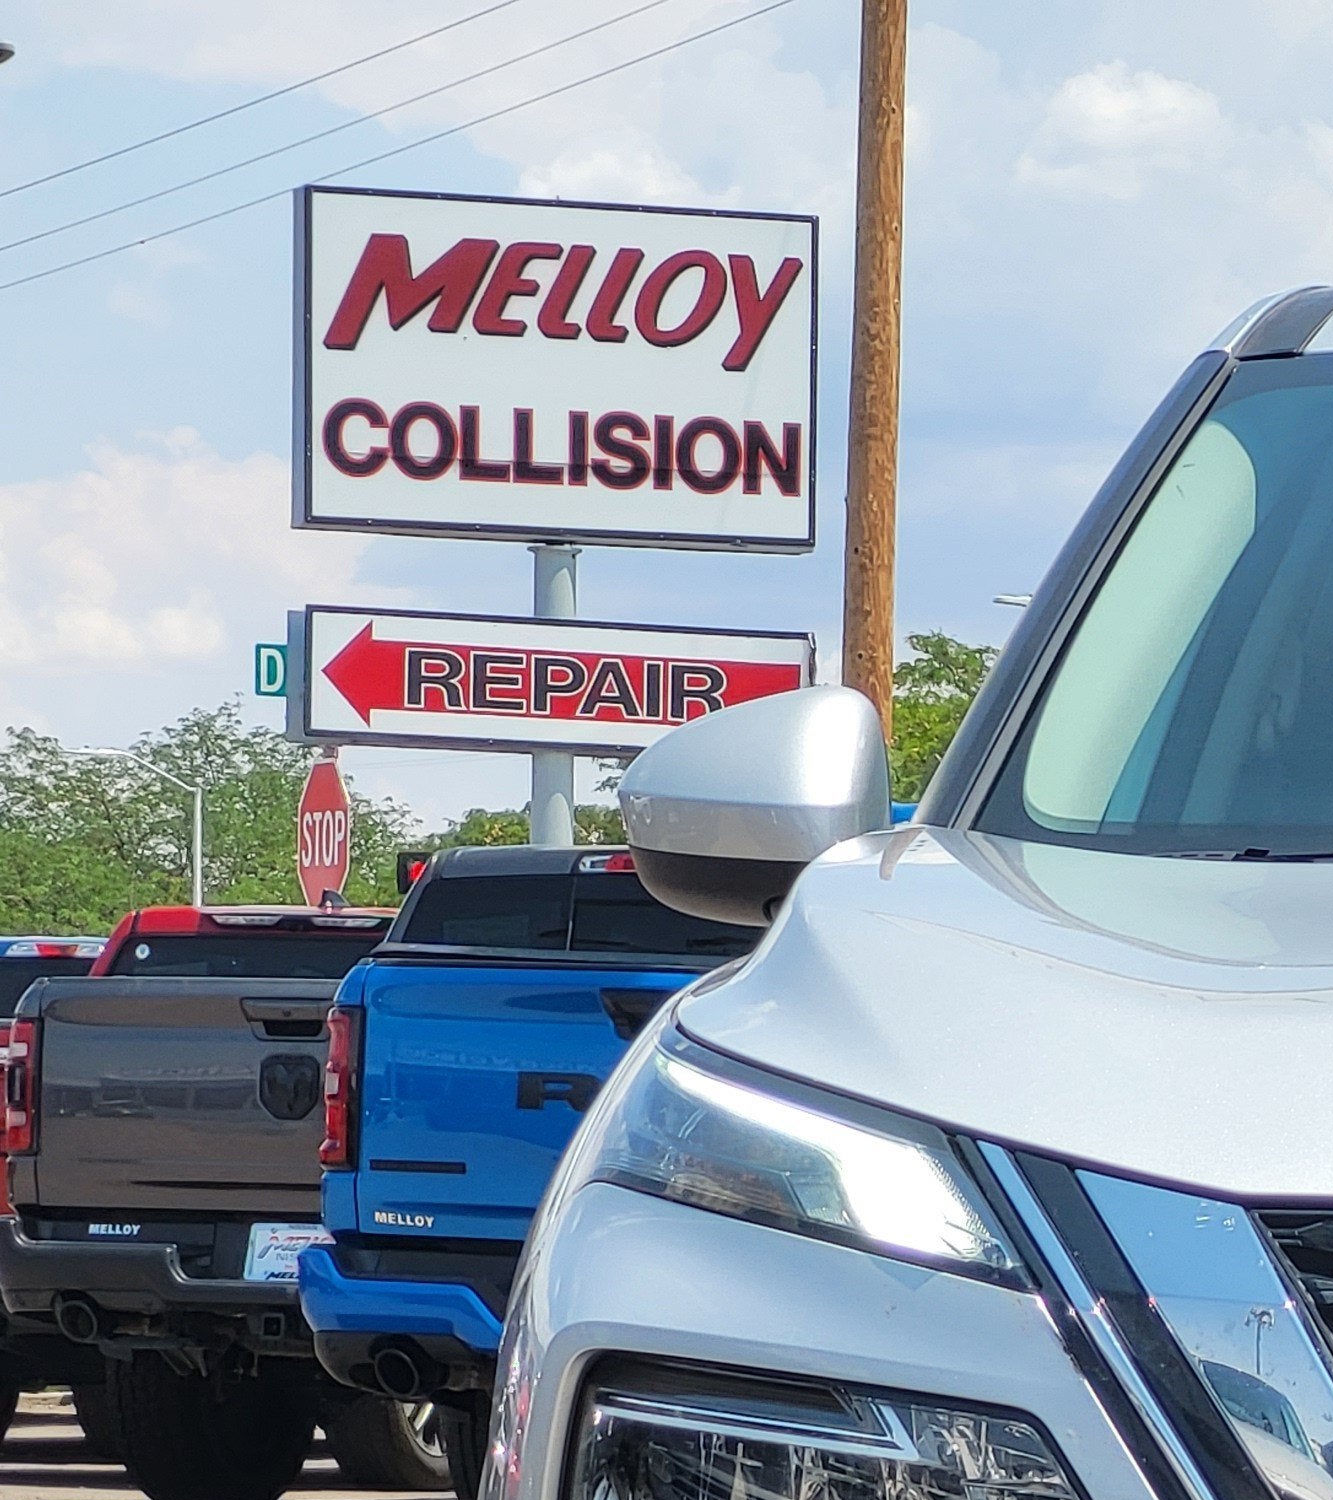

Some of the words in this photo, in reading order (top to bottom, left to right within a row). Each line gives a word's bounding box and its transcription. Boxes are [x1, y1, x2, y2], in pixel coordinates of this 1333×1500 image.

[323, 233, 803, 372] MELLOY
[322, 397, 802, 497] COLLISION
[260, 648, 285, 693] D
[404, 646, 728, 723] REPAIR
[301, 810, 346, 868] STOP
[88, 1223, 141, 1236] MELLOY
[374, 1210, 435, 1229] MELLOY
